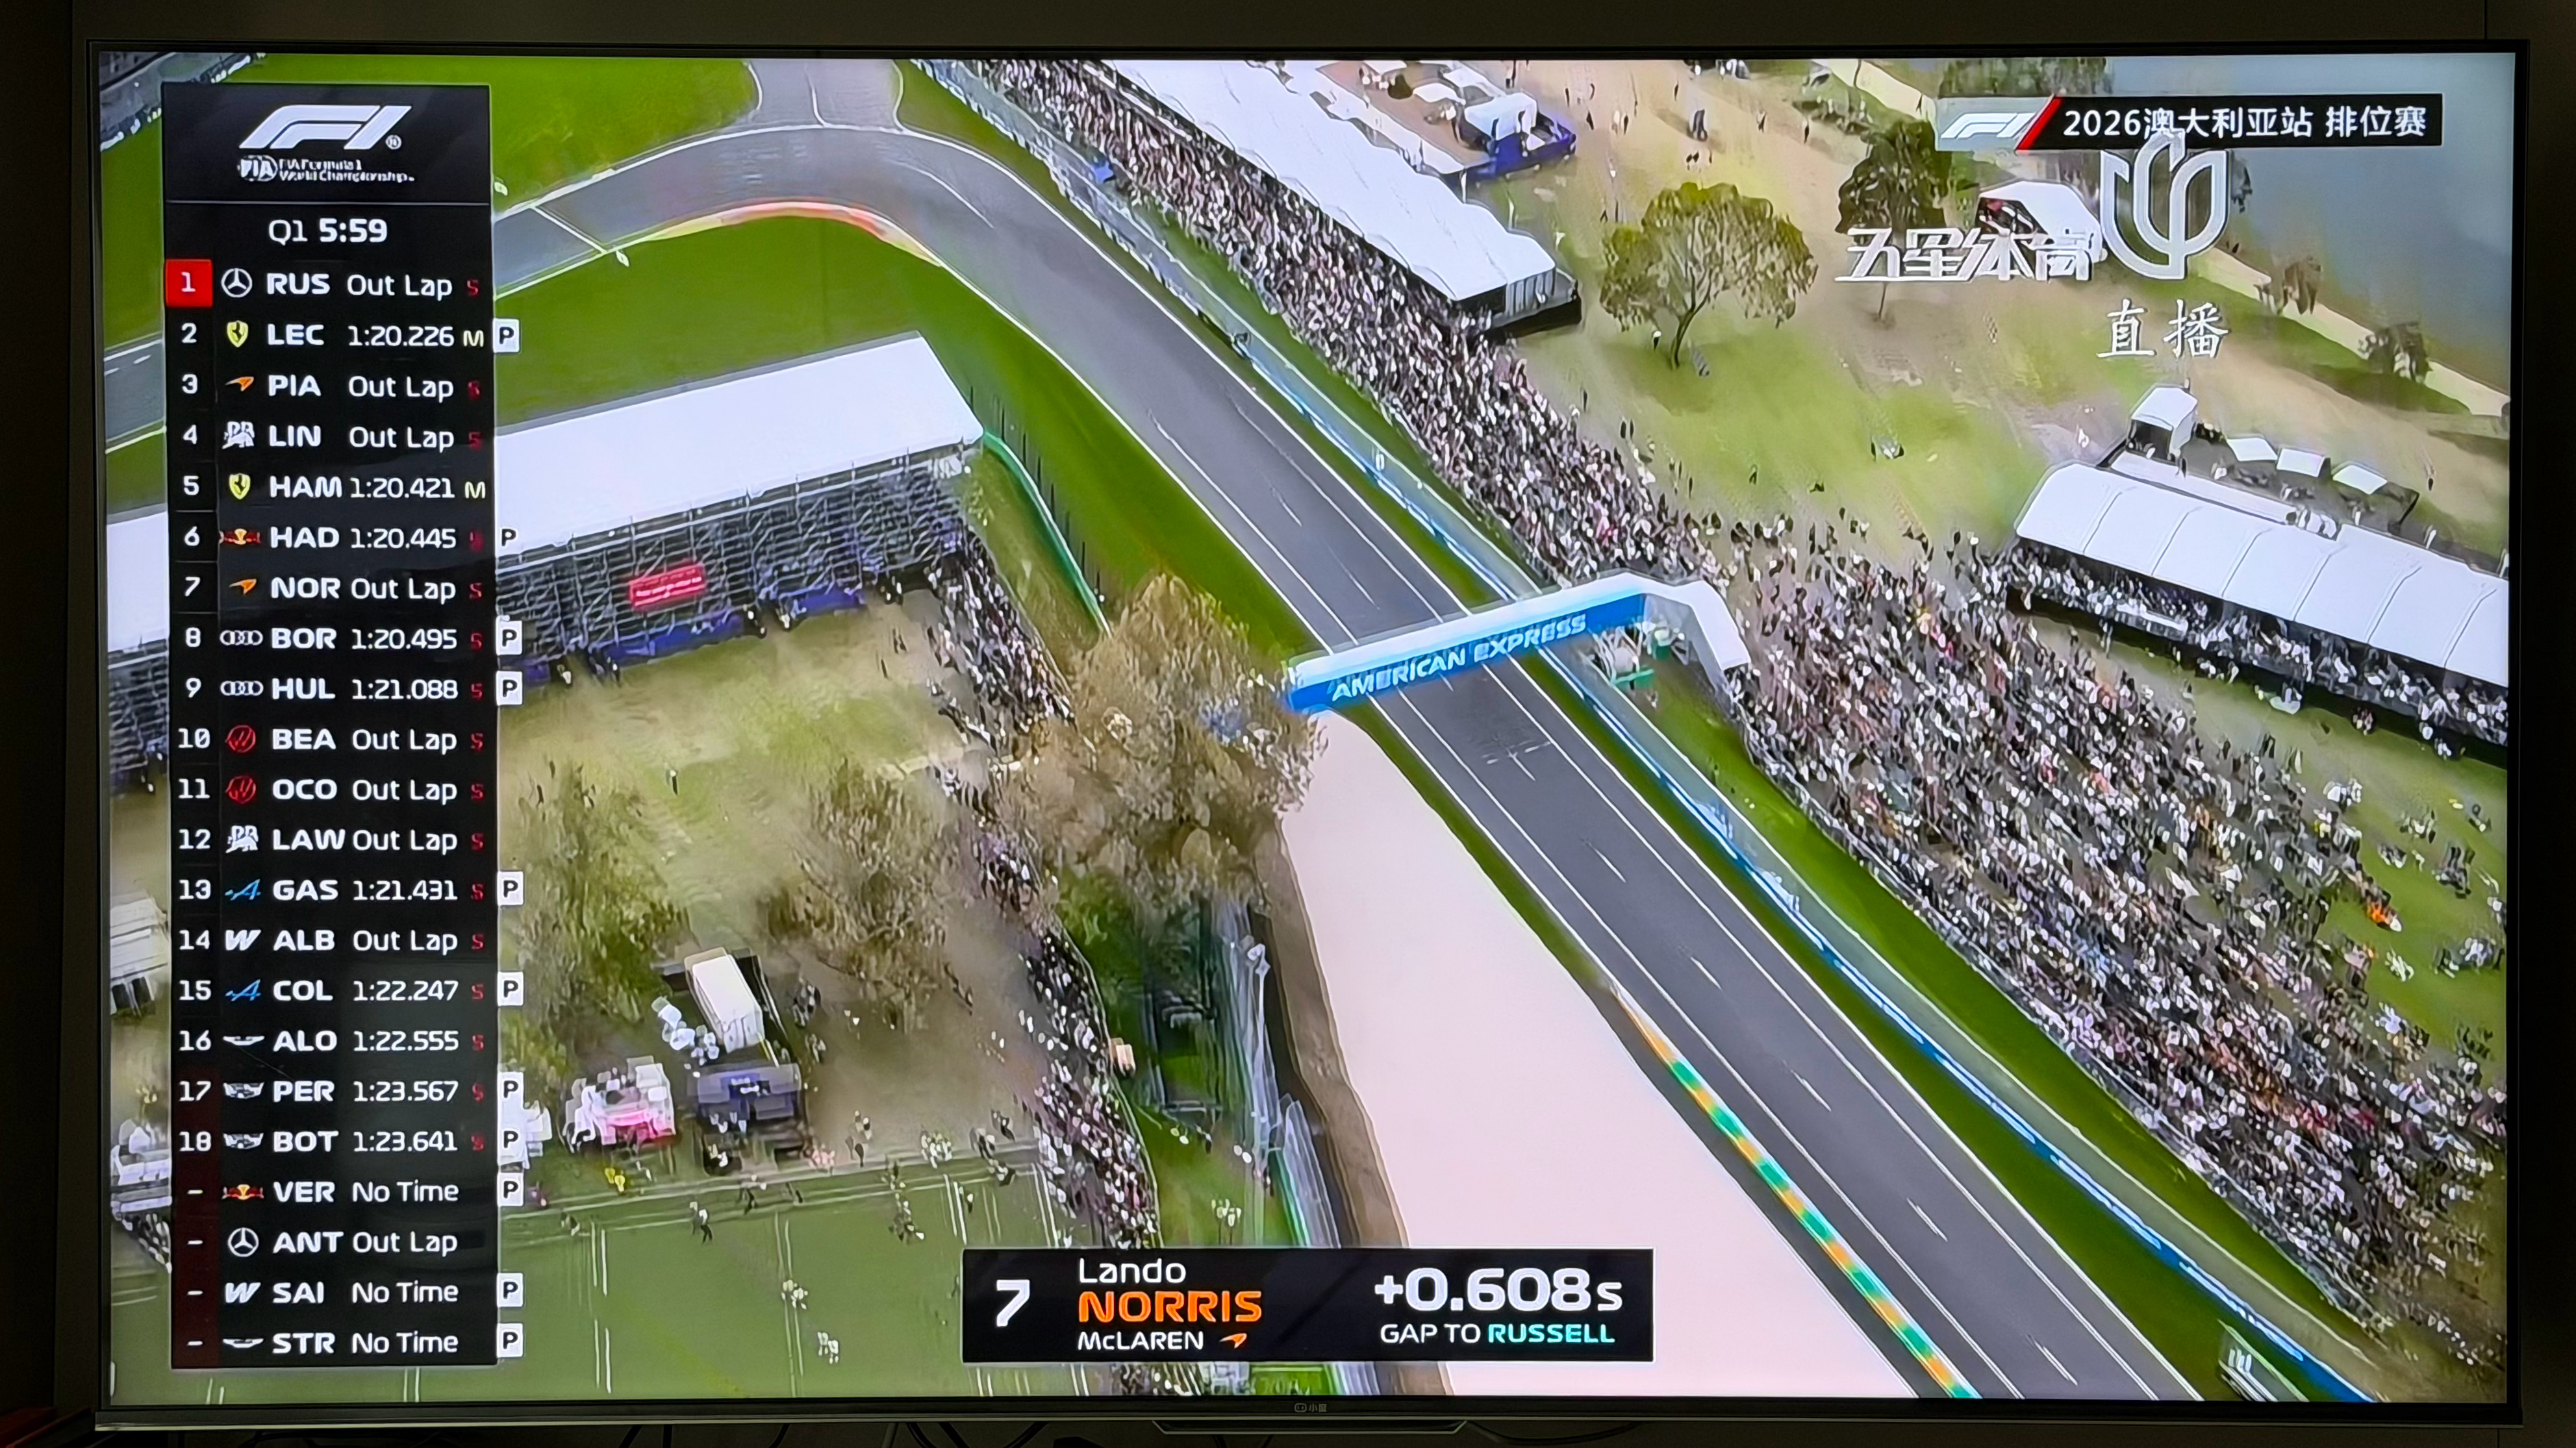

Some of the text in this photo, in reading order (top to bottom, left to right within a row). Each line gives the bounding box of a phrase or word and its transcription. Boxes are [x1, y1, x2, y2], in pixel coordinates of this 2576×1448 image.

[2063, 105, 2426, 138] 2026澳大利亚站 排位赛
[268, 218, 388, 246] Q1 5:59
[182, 271, 196, 292] 1
[266, 272, 331, 295] RUS
[347, 274, 395, 296] Out
[405, 274, 453, 301] Lap
[181, 323, 514, 347] 2 LEC 1:20.226 M P
[2097, 300, 2230, 360] 直播
[182, 373, 198, 394] 3
[268, 374, 322, 397] PIA
[348, 375, 396, 397] Out
[406, 376, 454, 403] Lap
[183, 424, 197, 445] 4
[269, 425, 321, 447] LIN
[349, 426, 397, 448] Out
[407, 427, 455, 453] Lap
[183, 475, 486, 499] 5 HAM 1:20.421 M
[184, 526, 200, 546] 6
[270, 526, 340, 549] HAD
[350, 528, 457, 549] 1:20.445
[501, 529, 516, 546] P
[184, 577, 201, 597] 7
[271, 577, 341, 599] NOR
[351, 577, 399, 599] Out
[409, 577, 456, 605] Lap
[185, 627, 201, 647] 8
[271, 627, 337, 649] BOR
[351, 629, 457, 650] 1:20.495
[502, 629, 517, 647] P
[1329, 613, 1587, 703] AMERICAN EXPRESS
[186, 677, 201, 698] 9
[271, 677, 336, 700] HUL
[352, 679, 459, 700] 1:21.088
[502, 679, 517, 697] P
[178, 728, 210, 749] 10
[272, 728, 336, 750] BEA
[352, 729, 400, 750] Out
[410, 729, 457, 755] Lap
[179, 778, 210, 799] 11
[272, 779, 338, 800] OCO
[352, 779, 400, 801] Out
[410, 779, 457, 806] Lap
[179, 829, 210, 849] 12
[273, 829, 346, 851] LAW
[353, 829, 401, 851] Out
[410, 829, 458, 856] Lap
[179, 879, 211, 900] 13
[273, 879, 338, 901] GAS
[353, 880, 458, 901] 1:21.431
[503, 880, 518, 897] P
[179, 929, 210, 950] 14
[273, 929, 335, 951] ALB
[353, 930, 401, 951] Out
[410, 929, 458, 956] Lap
[179, 980, 211, 1001] 15
[273, 979, 333, 1001] COL
[353, 980, 459, 1001] 1:22.247
[503, 980, 518, 997] P
[179, 1030, 211, 1051] 16
[273, 1030, 337, 1052] ALO
[353, 1030, 459, 1051] 1:22.555
[179, 1080, 211, 1102] 17
[273, 1080, 335, 1103] PER
[353, 1080, 459, 1102] 1:23.567
[503, 1080, 518, 1098] P
[179, 1131, 212, 1152] 18
[273, 1130, 339, 1153] BOT
[353, 1130, 458, 1153] 1:23.641
[503, 1130, 518, 1148] P
[273, 1179, 518, 1203] VER No Time P
[273, 1230, 458, 1257] ANT Out Lap
[1079, 1258, 1187, 1284] Lando
[273, 1280, 518, 1304] SAI No Time P
[1374, 1267, 1623, 1312] +0.608s
[996, 1279, 1030, 1327] 7
[1078, 1290, 1262, 1323] NORRIS
[272, 1330, 518, 1354] STR No Time P
[1078, 1330, 1204, 1351] McLAREN
[1380, 1323, 1615, 1344] GAP TO RUSSELL
